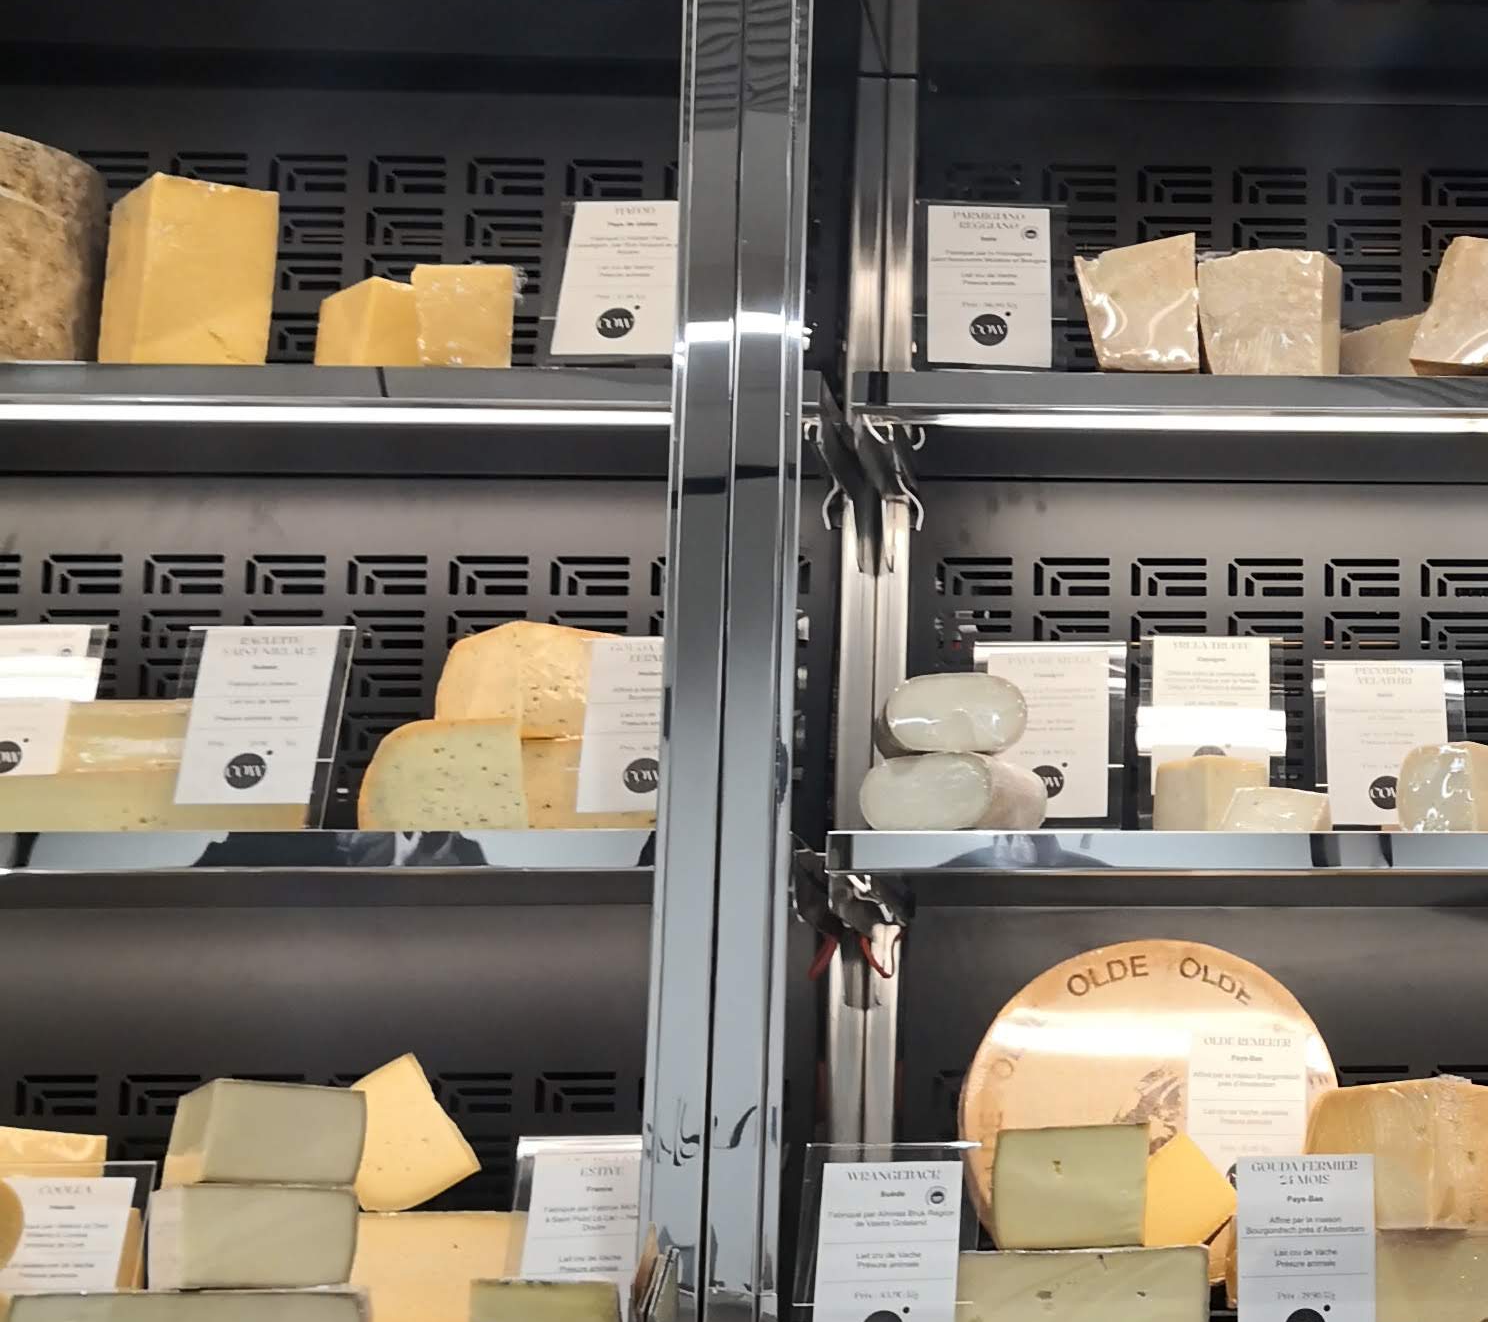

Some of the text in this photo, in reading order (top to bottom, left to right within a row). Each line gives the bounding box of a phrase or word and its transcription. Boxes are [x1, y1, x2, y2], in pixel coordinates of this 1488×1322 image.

[1066, 955, 1252, 1006] OLDE OLDE
[1251, 1161, 1358, 1172] GOUDA FERMIER
[1297, 1175, 1330, 1185] MOIS
